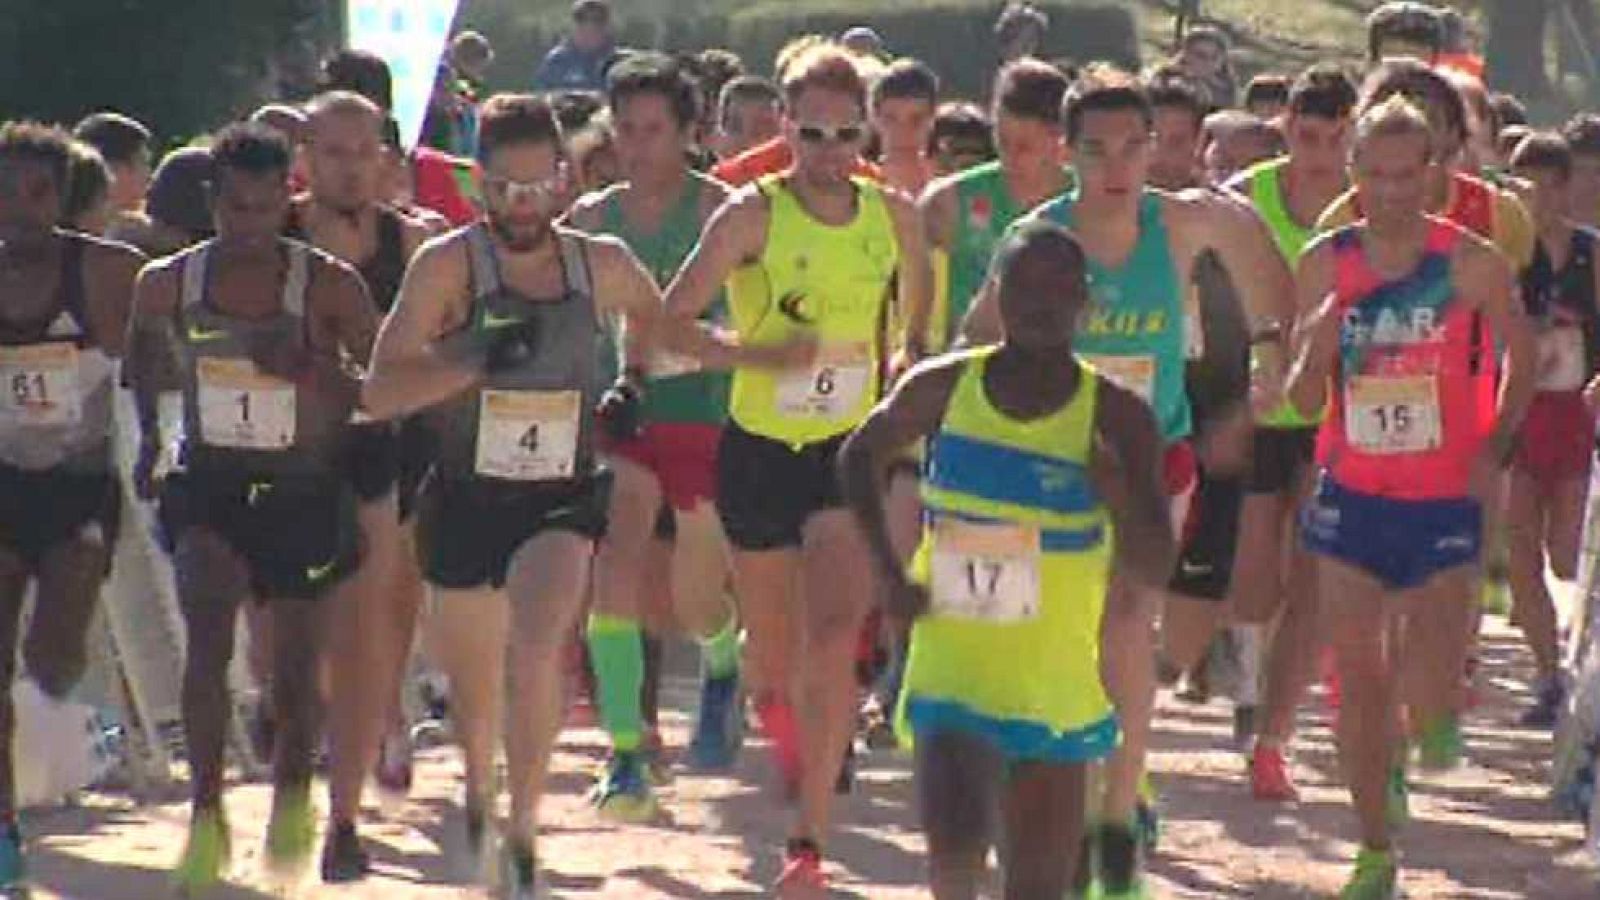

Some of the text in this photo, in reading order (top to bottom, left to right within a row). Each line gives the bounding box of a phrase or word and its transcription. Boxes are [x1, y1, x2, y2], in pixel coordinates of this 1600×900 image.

[12, 373, 47, 402] 61
[816, 367, 834, 395] 6
[235, 391, 249, 422] 1
[519, 424, 539, 454] 4
[967, 560, 1002, 595] 17
